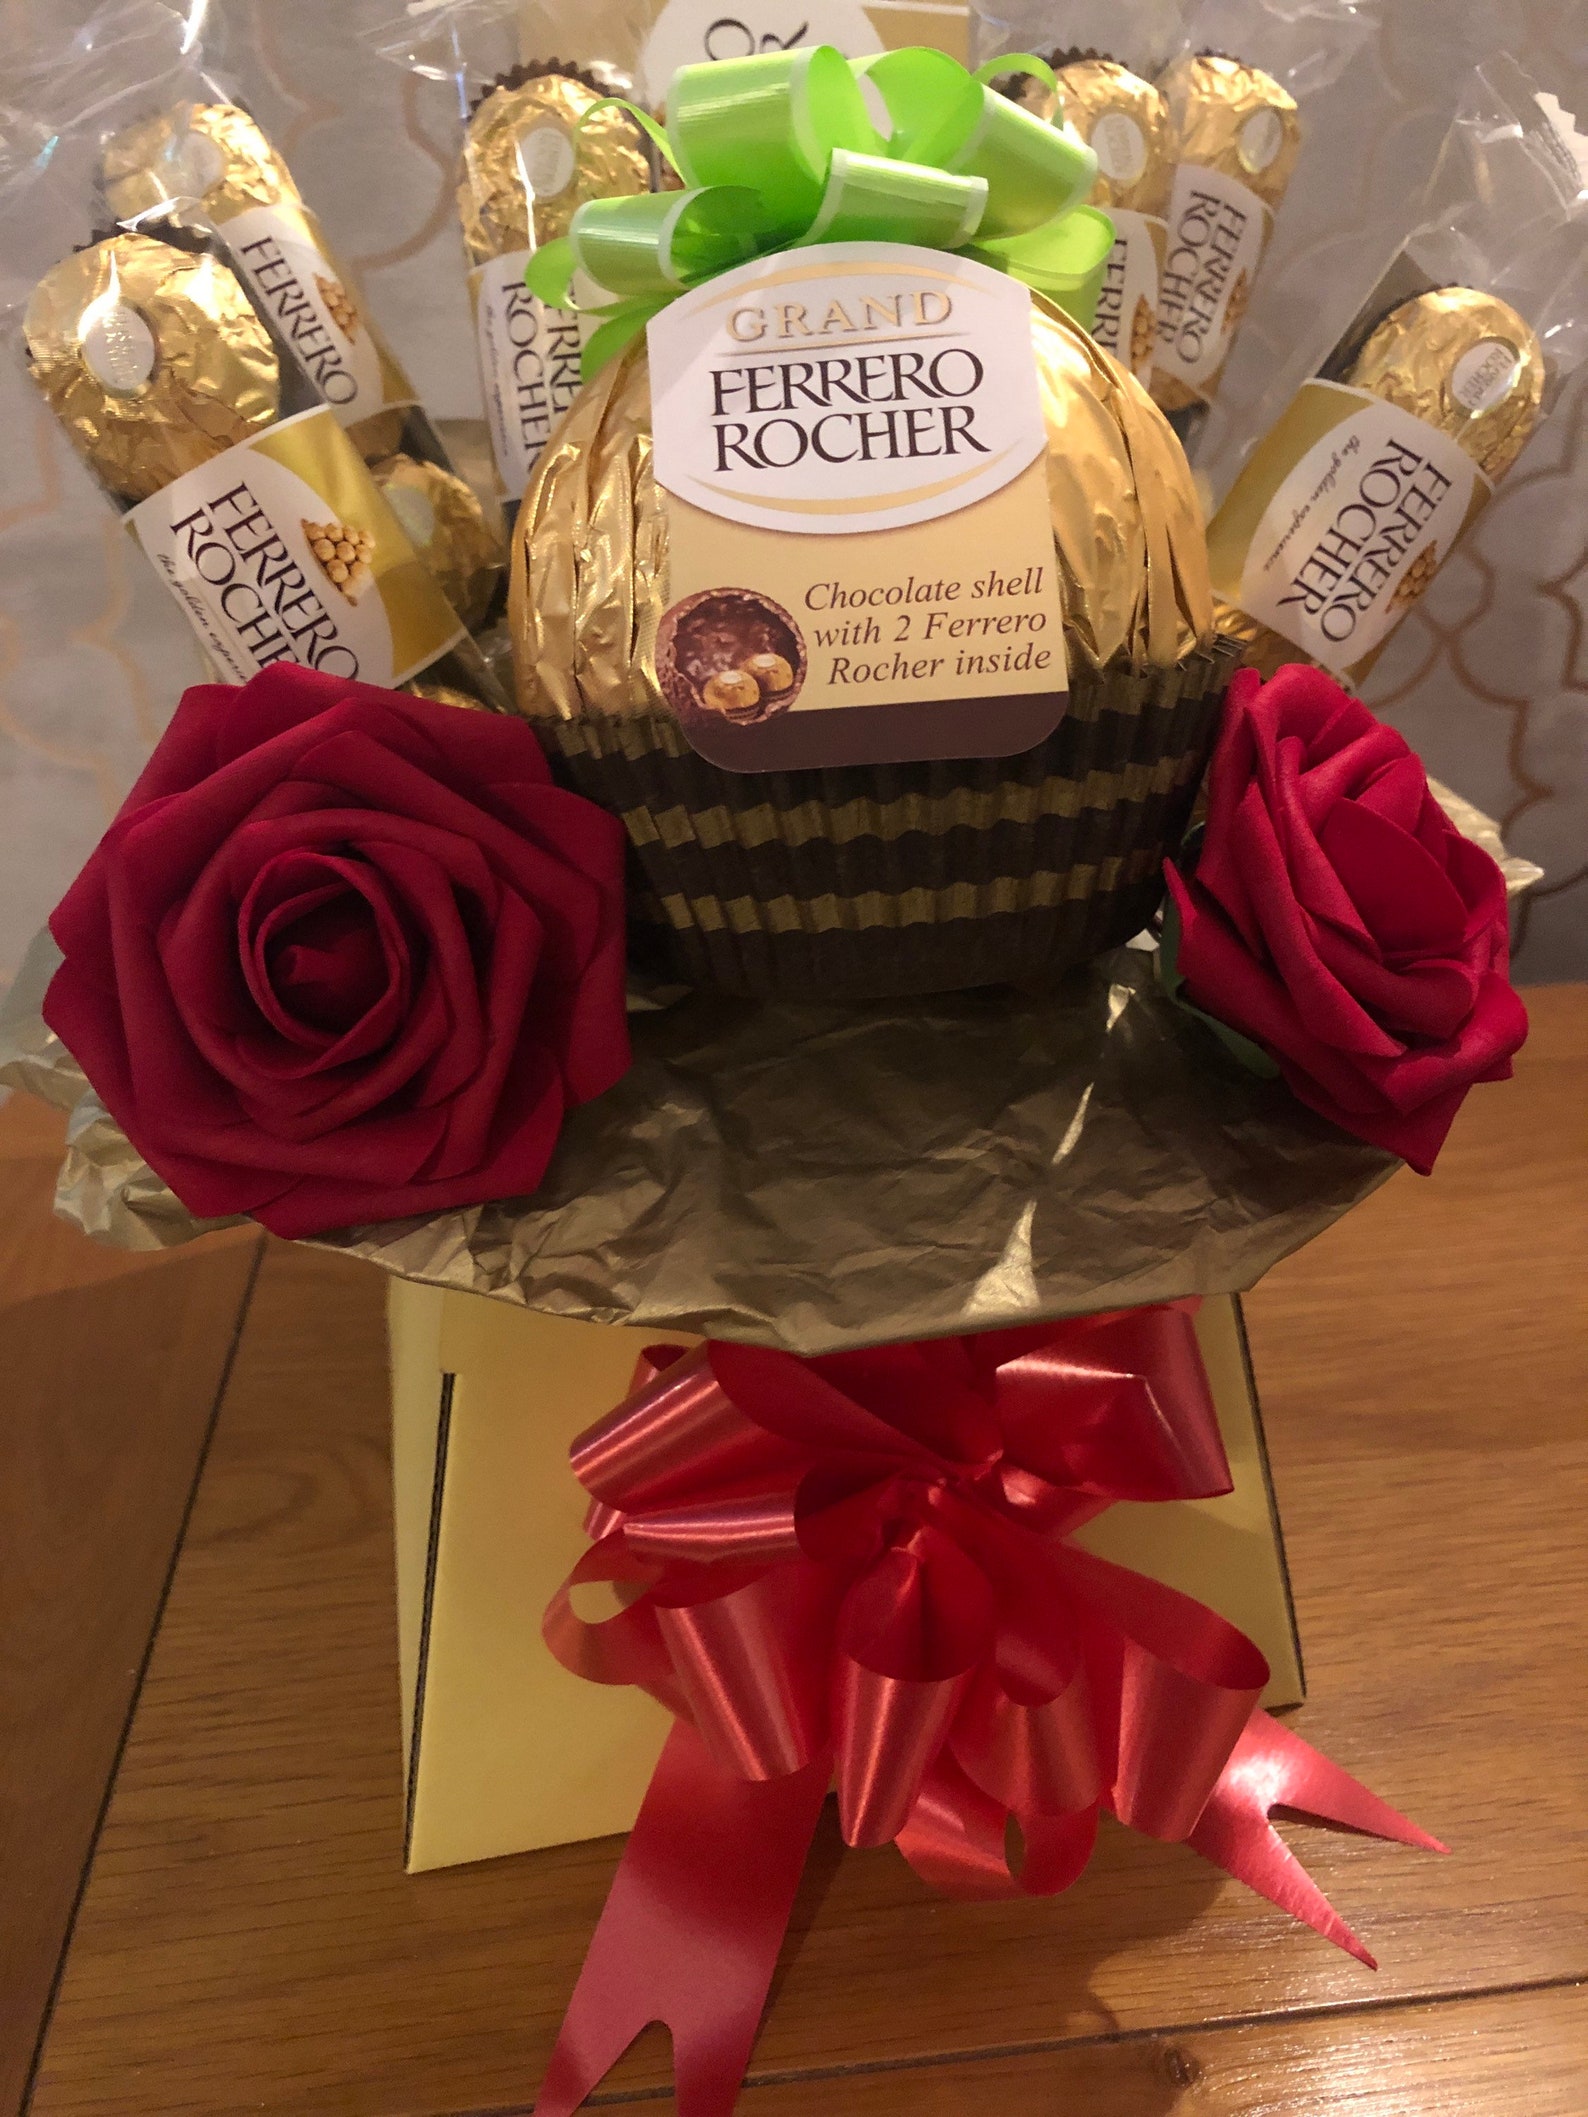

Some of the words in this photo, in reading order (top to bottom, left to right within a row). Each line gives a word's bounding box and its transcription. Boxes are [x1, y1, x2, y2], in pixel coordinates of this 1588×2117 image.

[240, 236, 358, 405] FERRERO
[726, 290, 953, 343] GRAND
[1176, 202, 1247, 364] FERRERO
[709, 348, 984, 417] FERRERO
[712, 405, 992, 472] ROCHER
[1275, 439, 1423, 615] ROCHER
[1321, 461, 1452, 642] FERRERO
[157, 553, 175, 578] the
[171, 579, 209, 629] golden
[170, 508, 300, 669] ROCHE
[208, 480, 360, 680] FERRERO
[805, 576, 961, 611] Chocolate
[971, 566, 1044, 600] shell
[813, 616, 881, 647] with
[893, 615, 911, 643] 2
[923, 611, 1047, 640] Ferrero
[828, 652, 945, 685] Rocher
[955, 642, 1051, 675] inside
